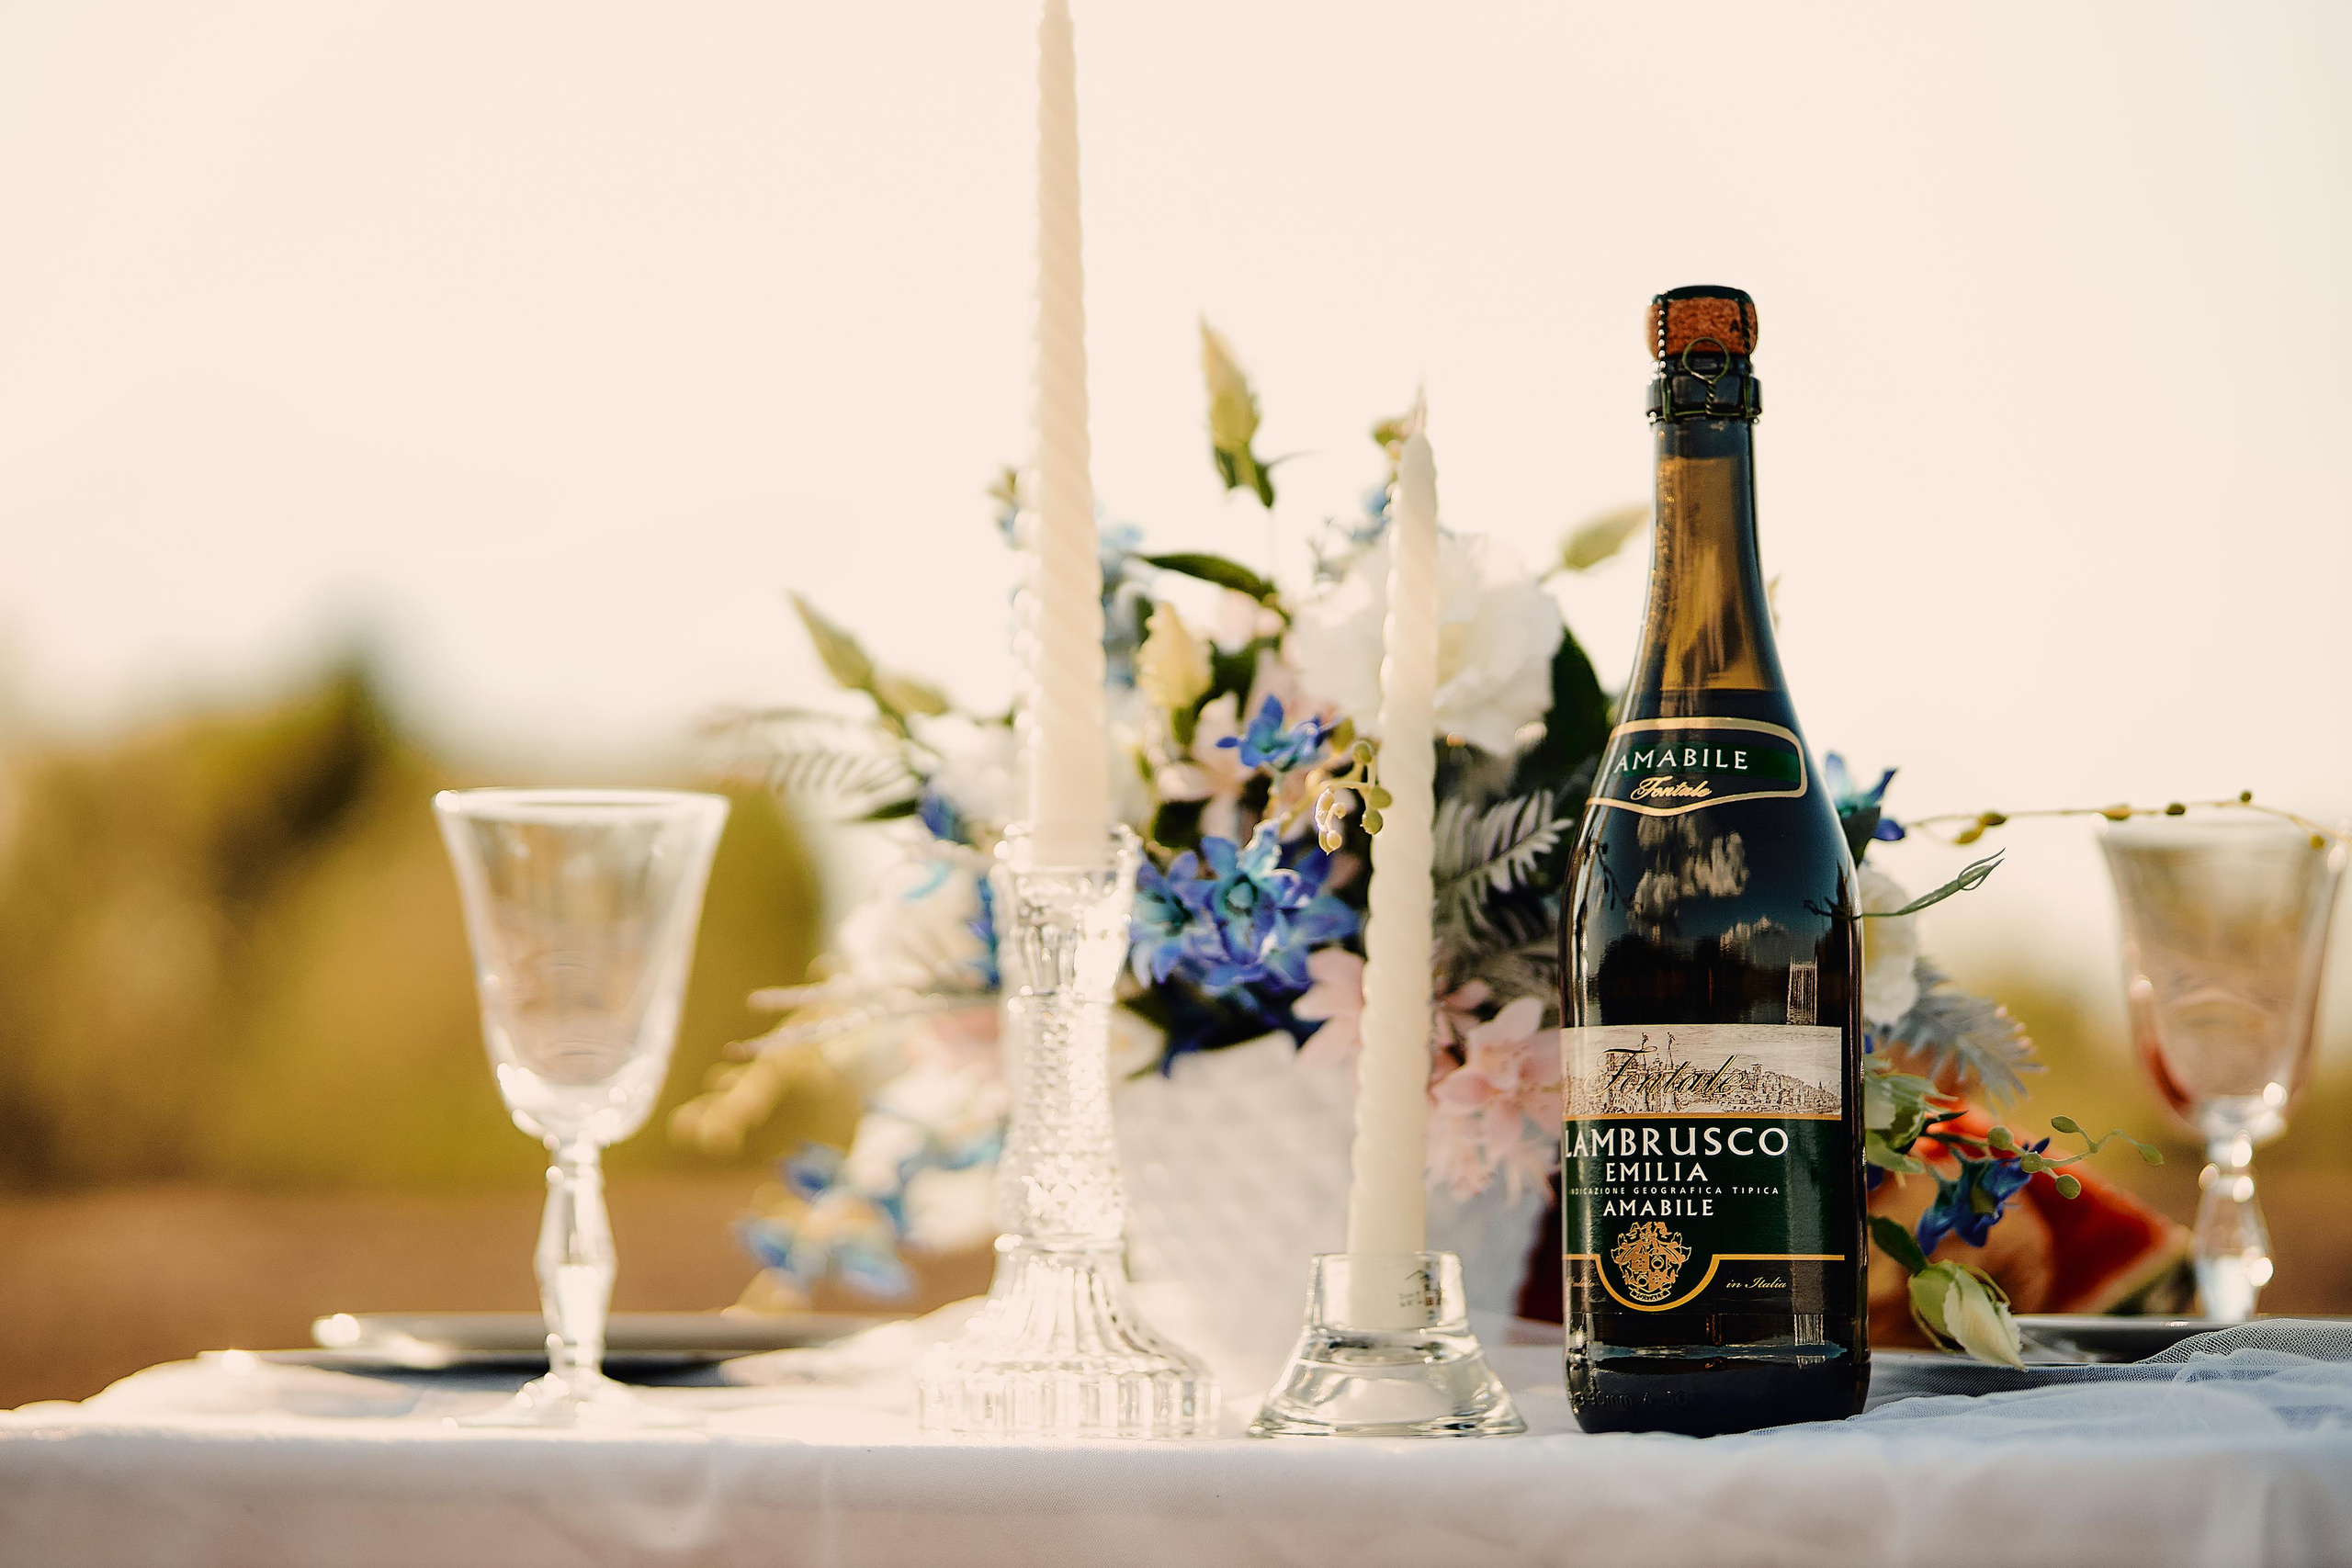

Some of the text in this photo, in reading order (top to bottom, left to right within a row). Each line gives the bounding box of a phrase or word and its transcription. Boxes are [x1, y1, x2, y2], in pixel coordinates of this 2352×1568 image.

[1613, 748, 1748, 773] AMABILE
[1630, 775, 1713, 801] Fontale
[1584, 1044, 1747, 1097] Fontale
[1565, 1126, 1790, 1157] LAMBRUSCO
[1606, 1162, 1709, 1182] EMILIA
[1569, 1186, 1780, 1195] INDICAZIONE GEOGRAFICA TIPICA
[1602, 1199, 1715, 1217] AMABILE
[1726, 1276, 1788, 1289] in Italia
